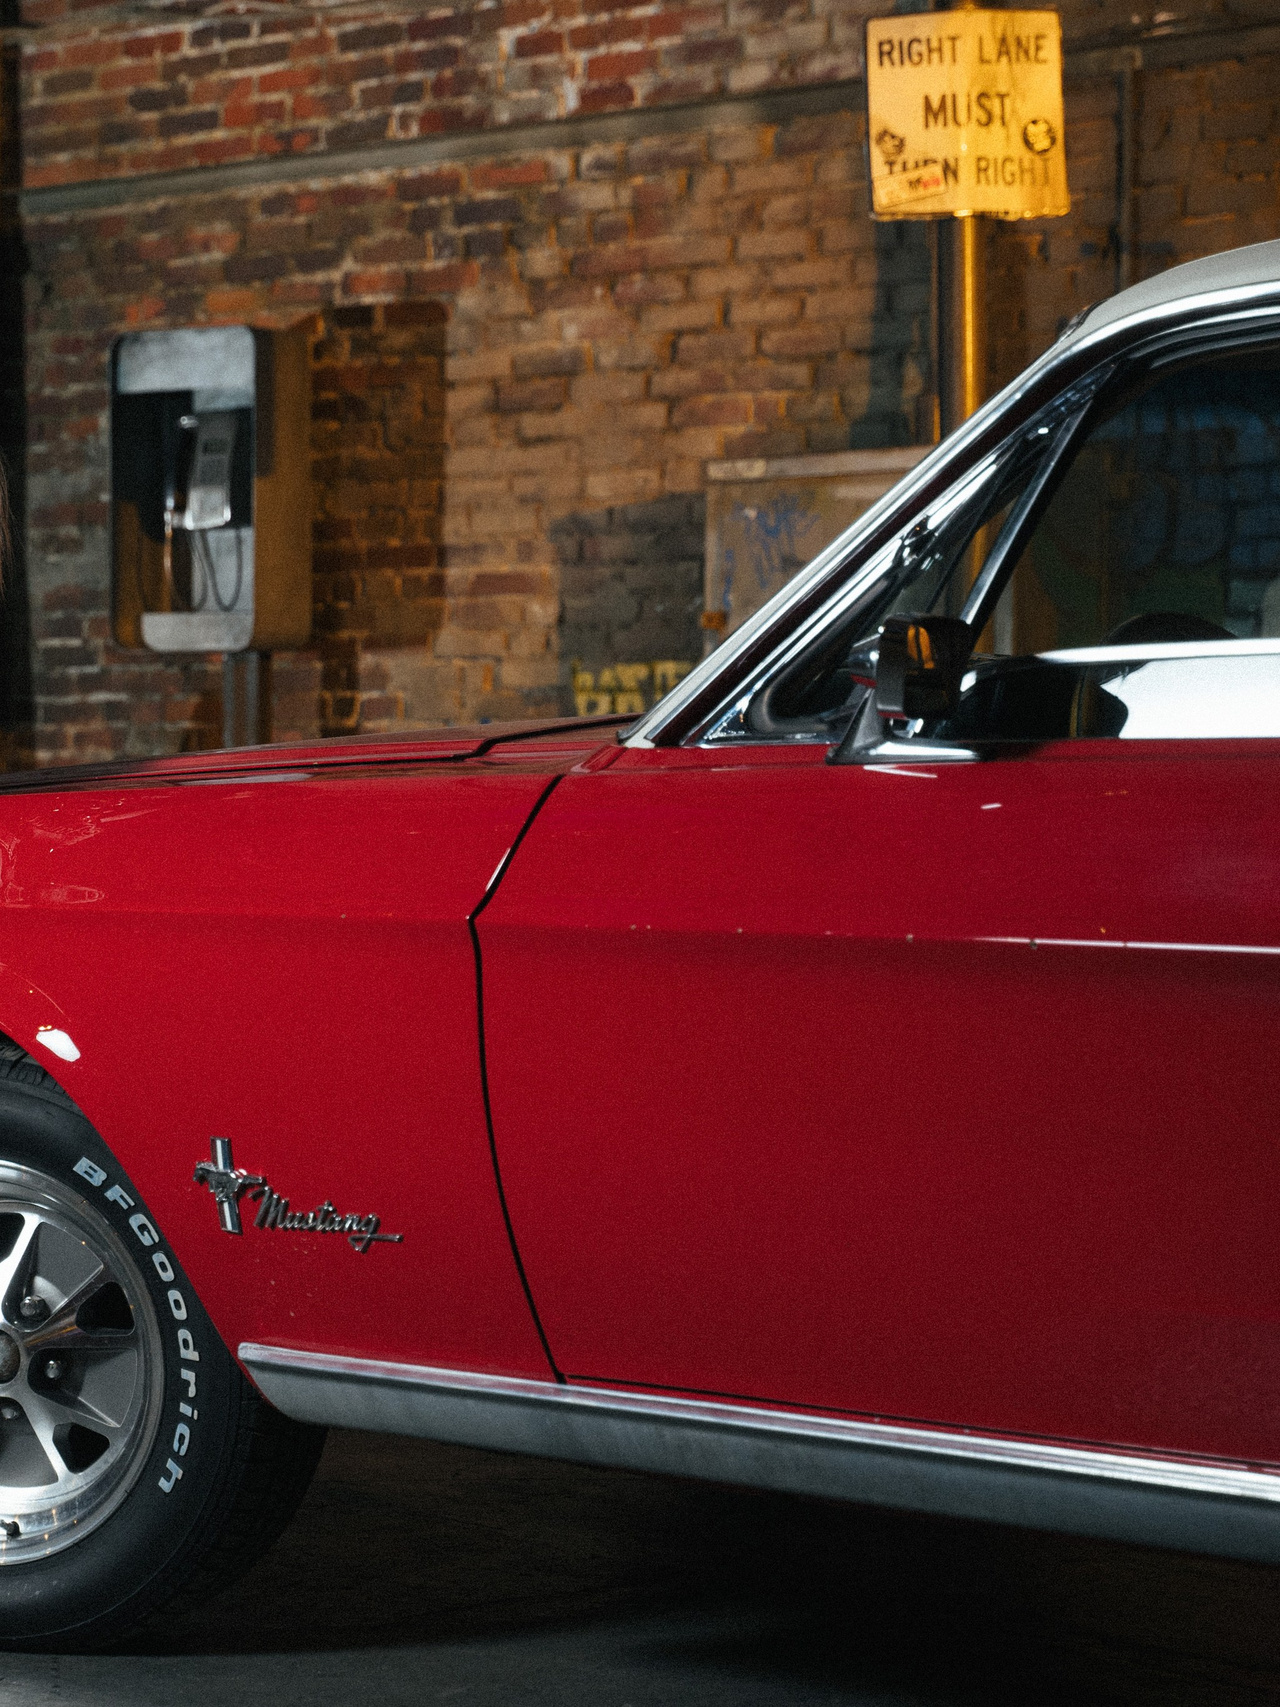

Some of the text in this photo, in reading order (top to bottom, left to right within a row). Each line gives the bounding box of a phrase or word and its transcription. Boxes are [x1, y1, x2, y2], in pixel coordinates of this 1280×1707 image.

[878, 34, 1049, 68] RIGHT LANE
[923, 92, 1010, 129] MUST
[884, 157, 959, 187] TN
[976, 156, 1052, 187] RIGHT
[248, 1185, 404, 1255] Mustang
[72, 1156, 202, 1494] BFGoodrich
